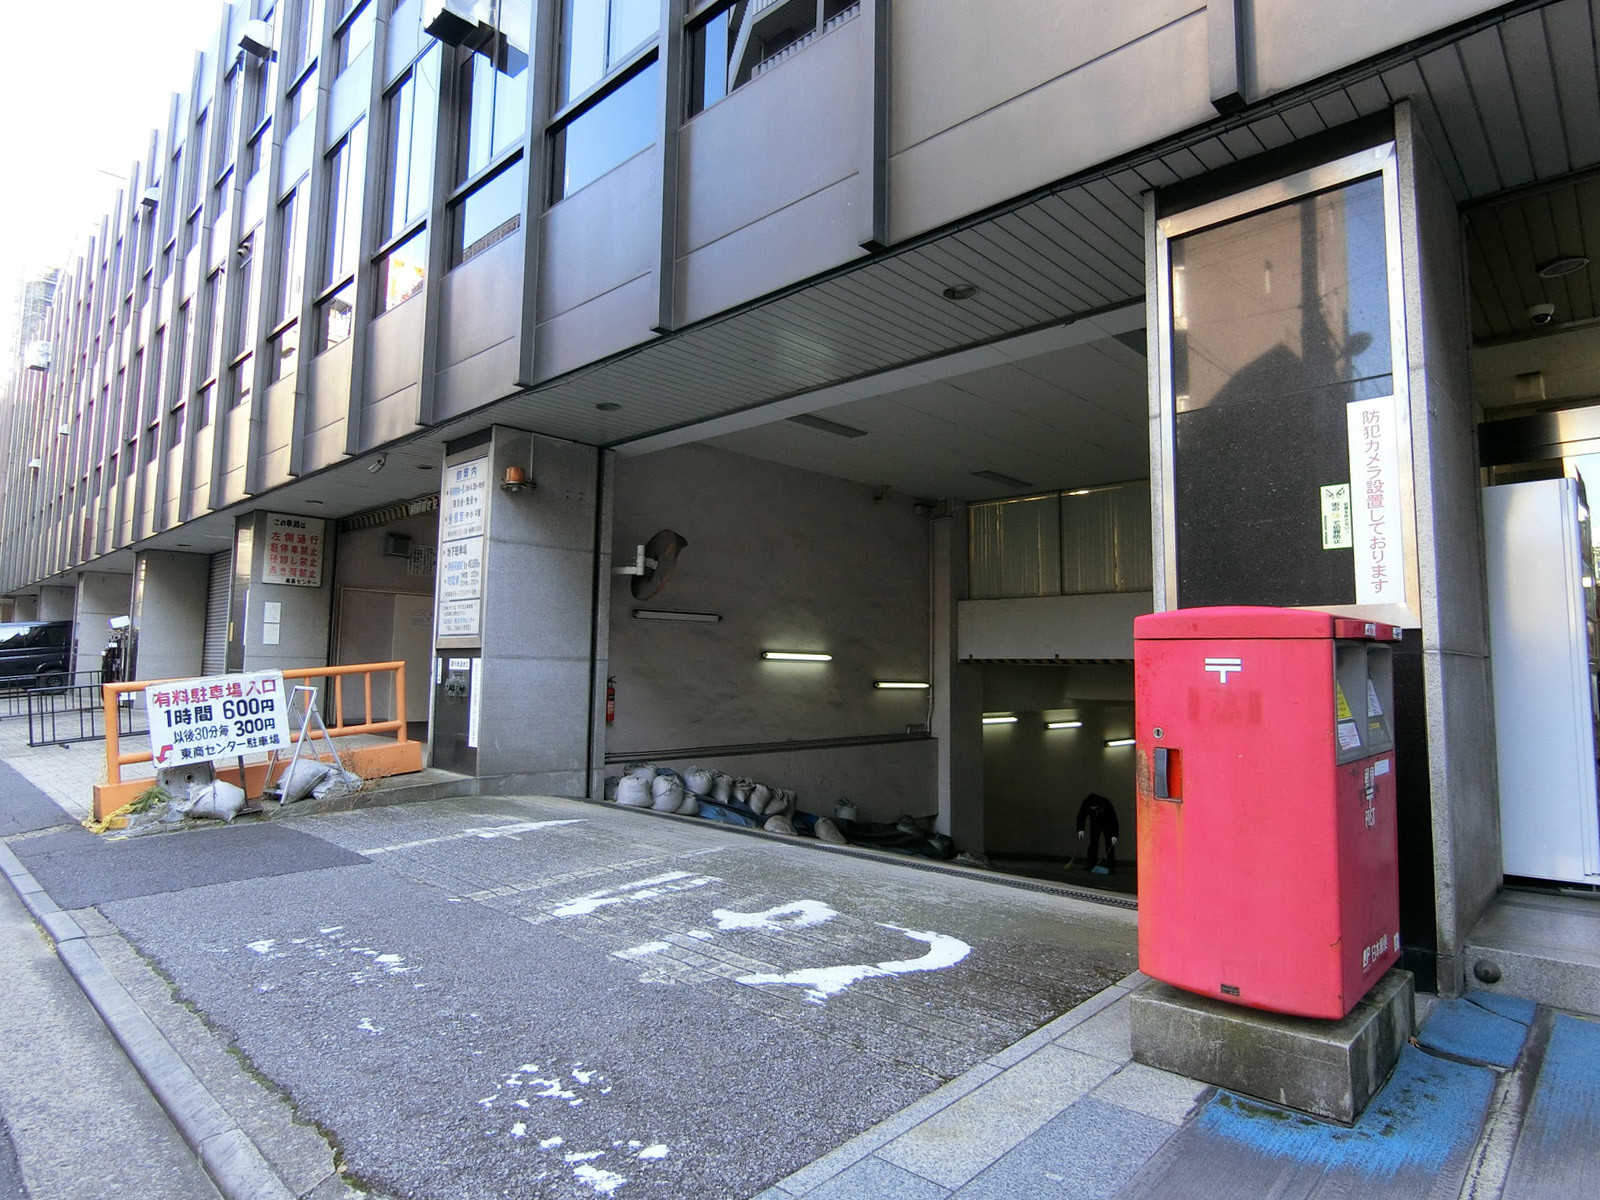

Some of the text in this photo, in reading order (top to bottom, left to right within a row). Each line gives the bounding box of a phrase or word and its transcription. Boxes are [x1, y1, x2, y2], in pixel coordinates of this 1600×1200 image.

[1362, 409, 1389, 594] 防犯カメラ設置しております
[269, 543, 318, 556] 駐停車禁止
[271, 531, 319, 546] 左側通行
[164, 698, 275, 728] 1時間 600円
[173, 718, 276, 744] 以後30分毎 300円
[180, 733, 281, 760] 東商センター駐車場
